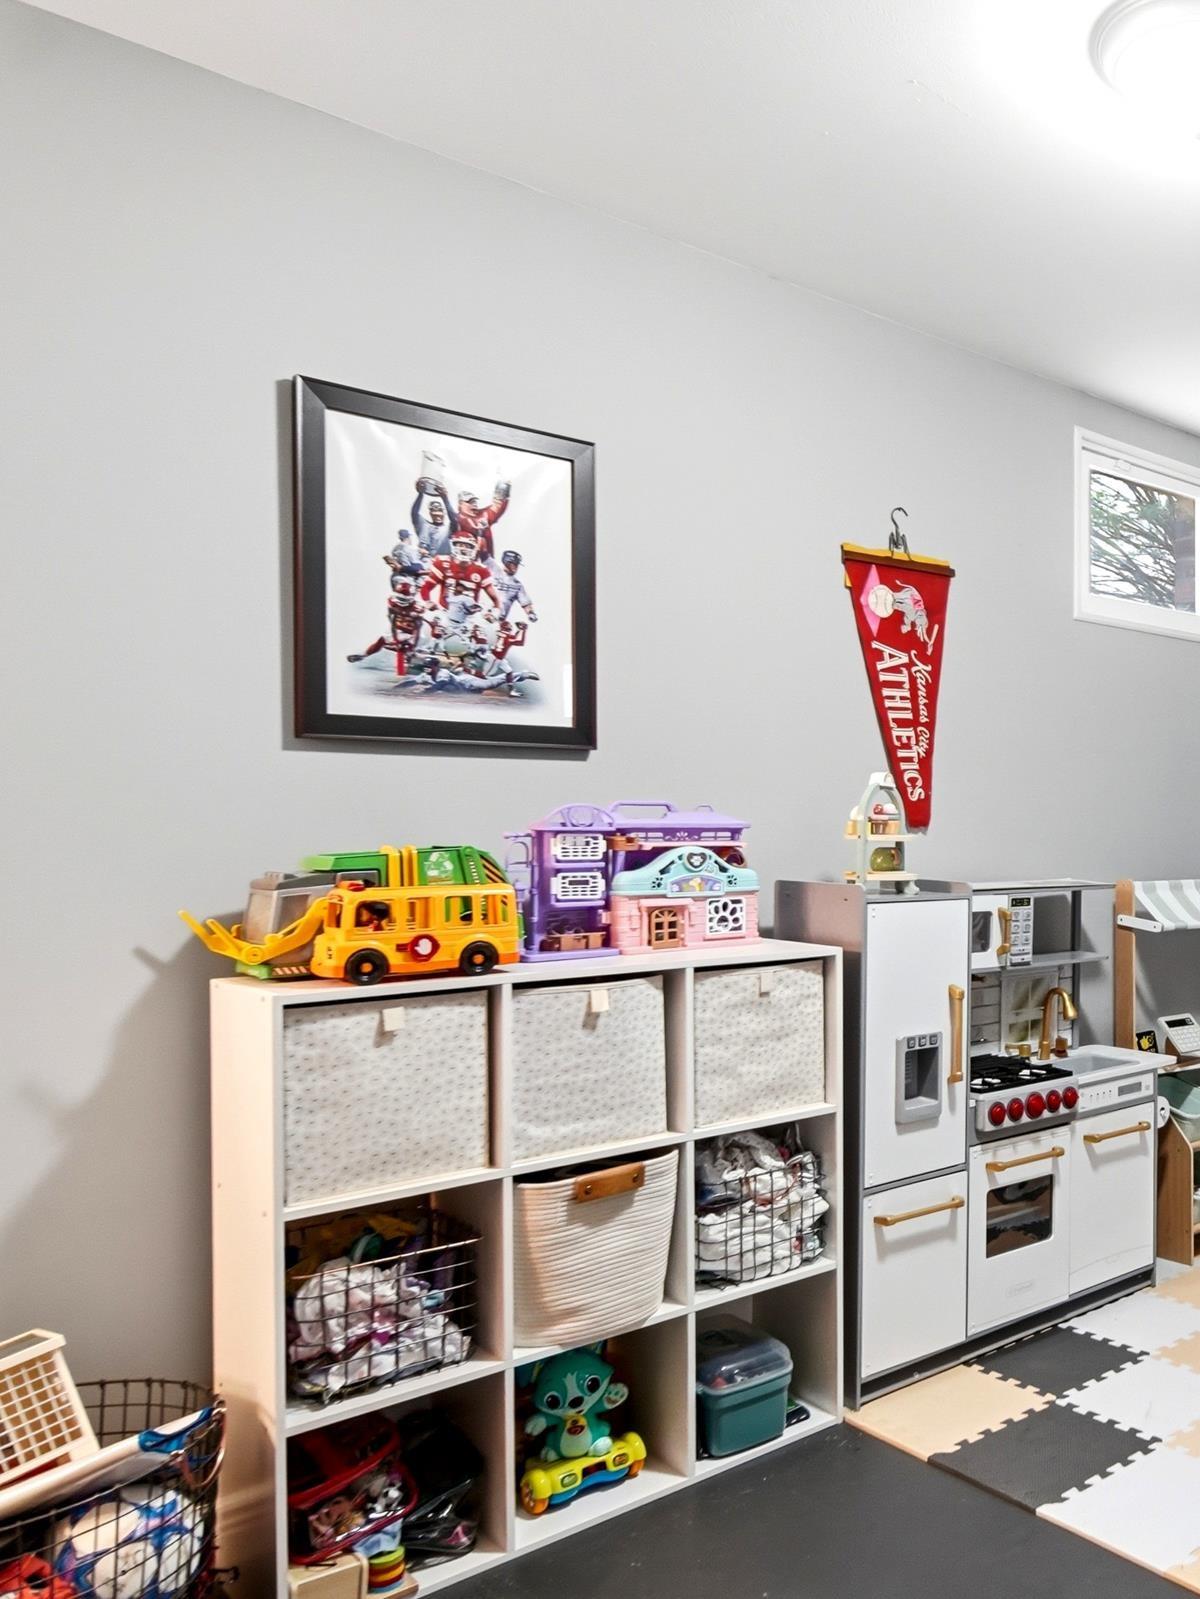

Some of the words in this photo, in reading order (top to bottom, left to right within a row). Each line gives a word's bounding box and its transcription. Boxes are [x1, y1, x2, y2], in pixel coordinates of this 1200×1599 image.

[871, 640, 926, 802] ATHLETICS
[910, 649, 932, 723] Kansas
[914, 726, 930, 758] City
